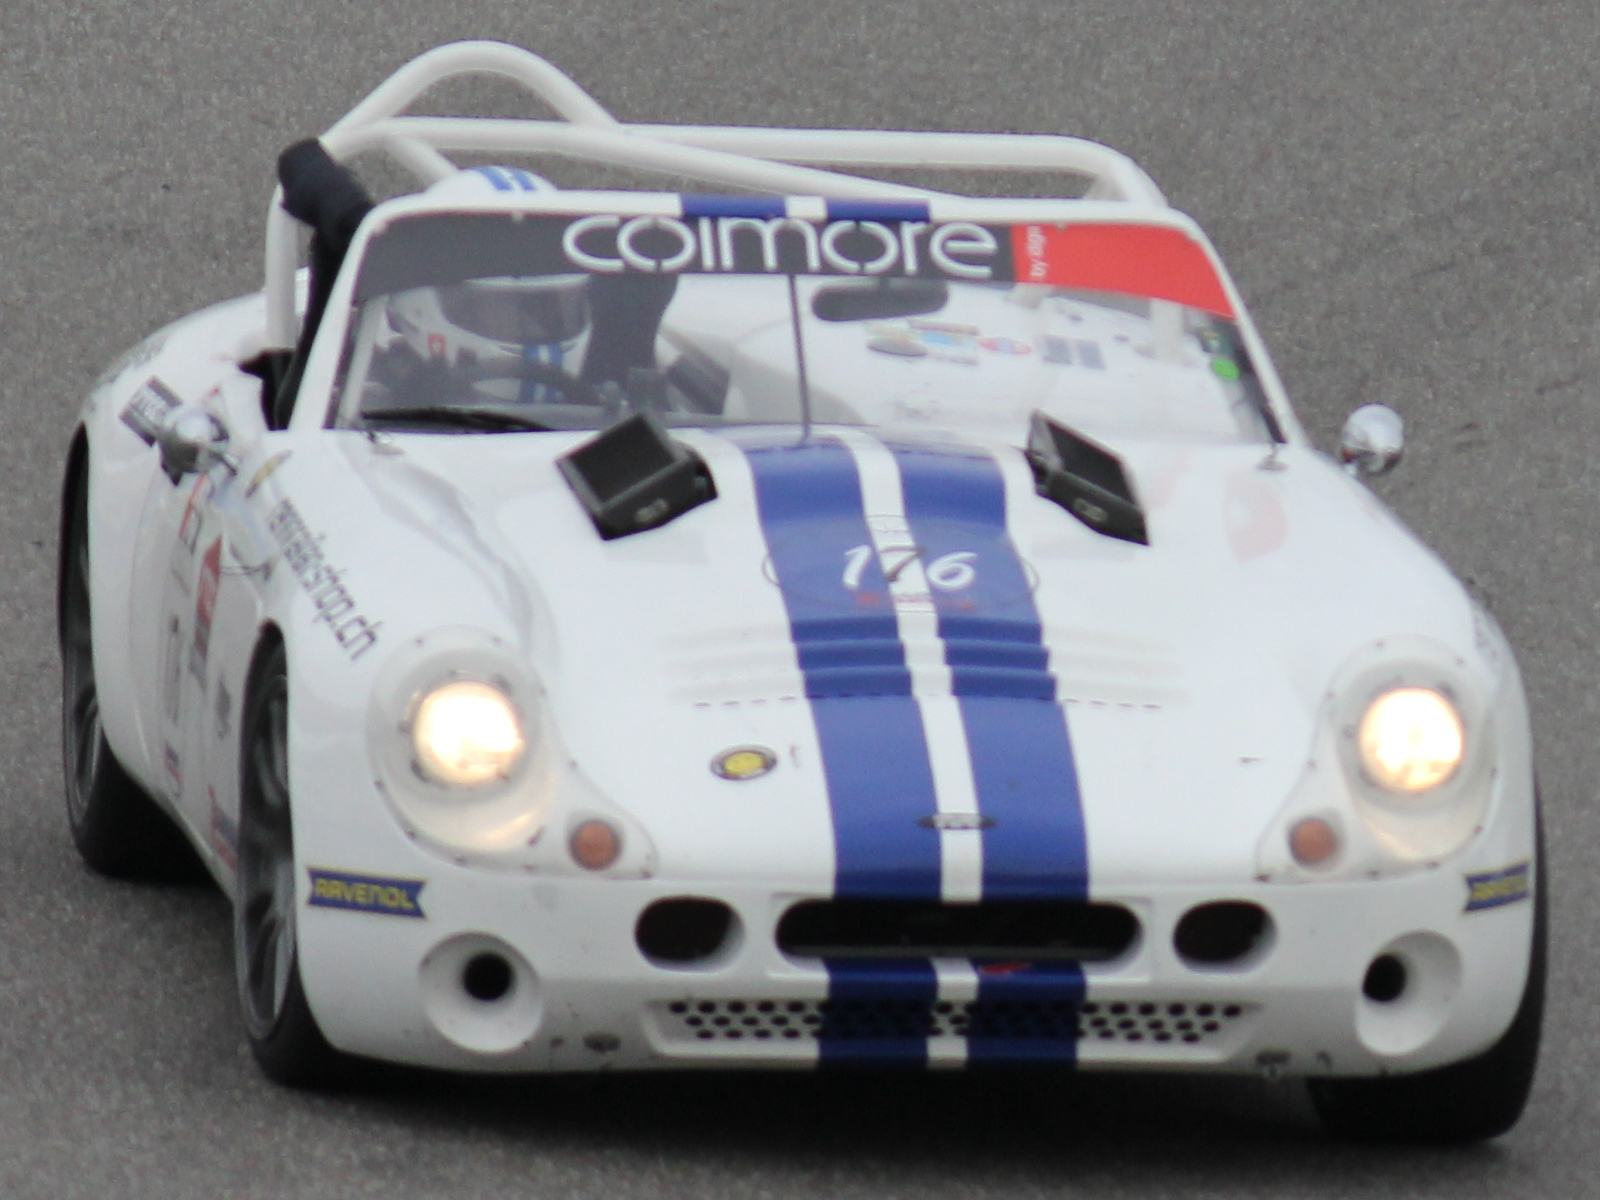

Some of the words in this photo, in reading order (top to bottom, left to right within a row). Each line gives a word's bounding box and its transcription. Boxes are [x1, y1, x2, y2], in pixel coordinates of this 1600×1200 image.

[562, 213, 999, 279] coimore
[842, 544, 979, 591] 176
[314, 878, 415, 910] RAVENOL
